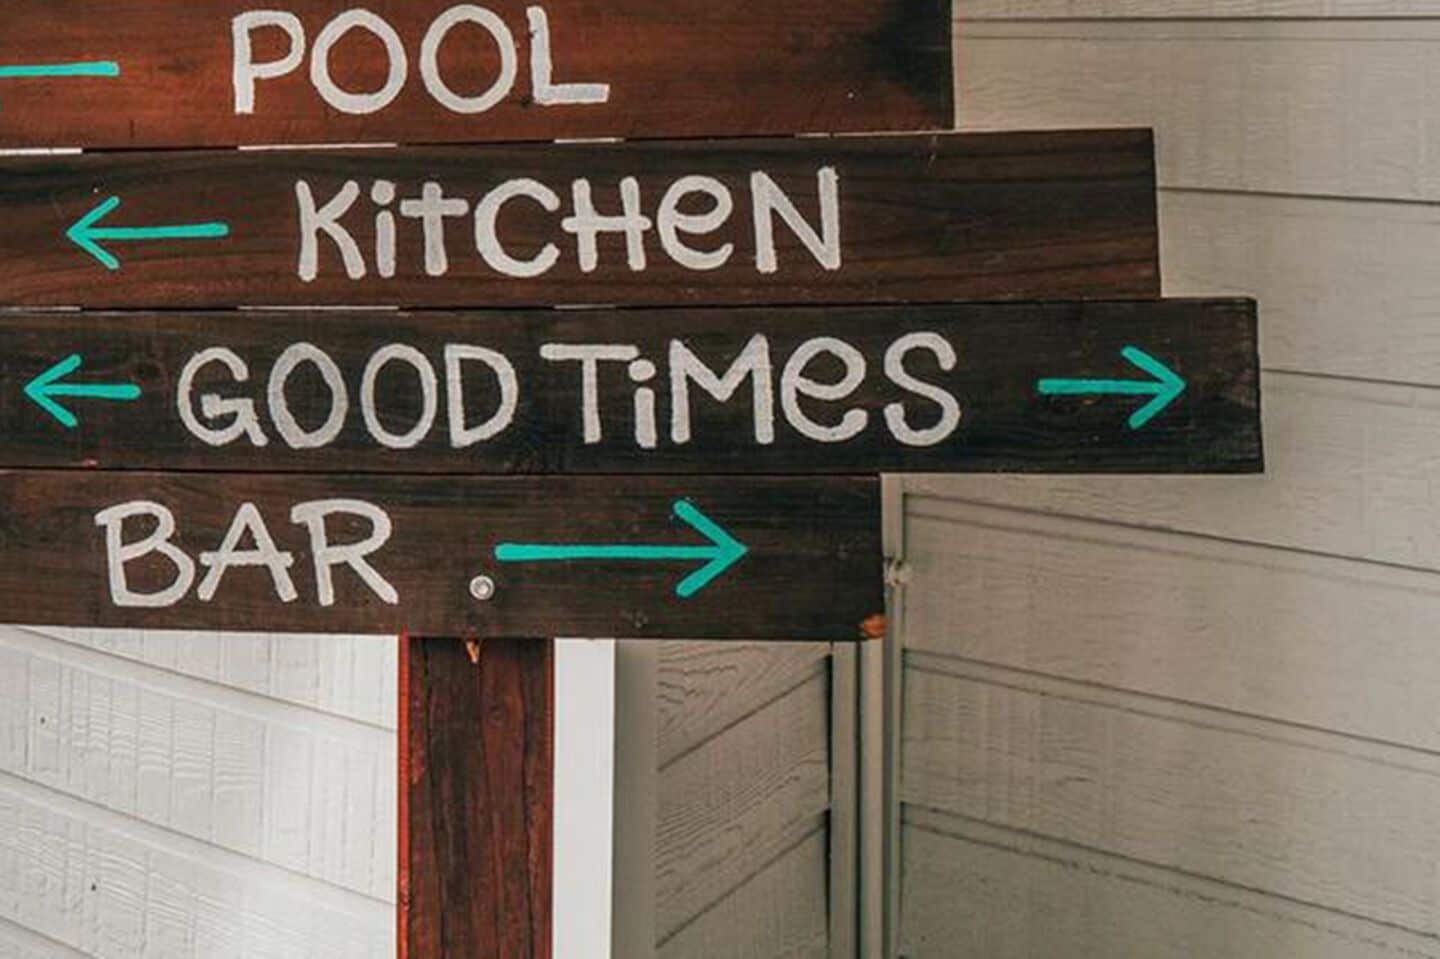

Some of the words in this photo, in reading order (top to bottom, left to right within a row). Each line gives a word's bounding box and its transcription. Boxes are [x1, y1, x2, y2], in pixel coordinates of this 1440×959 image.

[231, 4, 610, 115] POOL
[177, 342, 519, 449] GOOD
[94, 498, 399, 608] BAR
